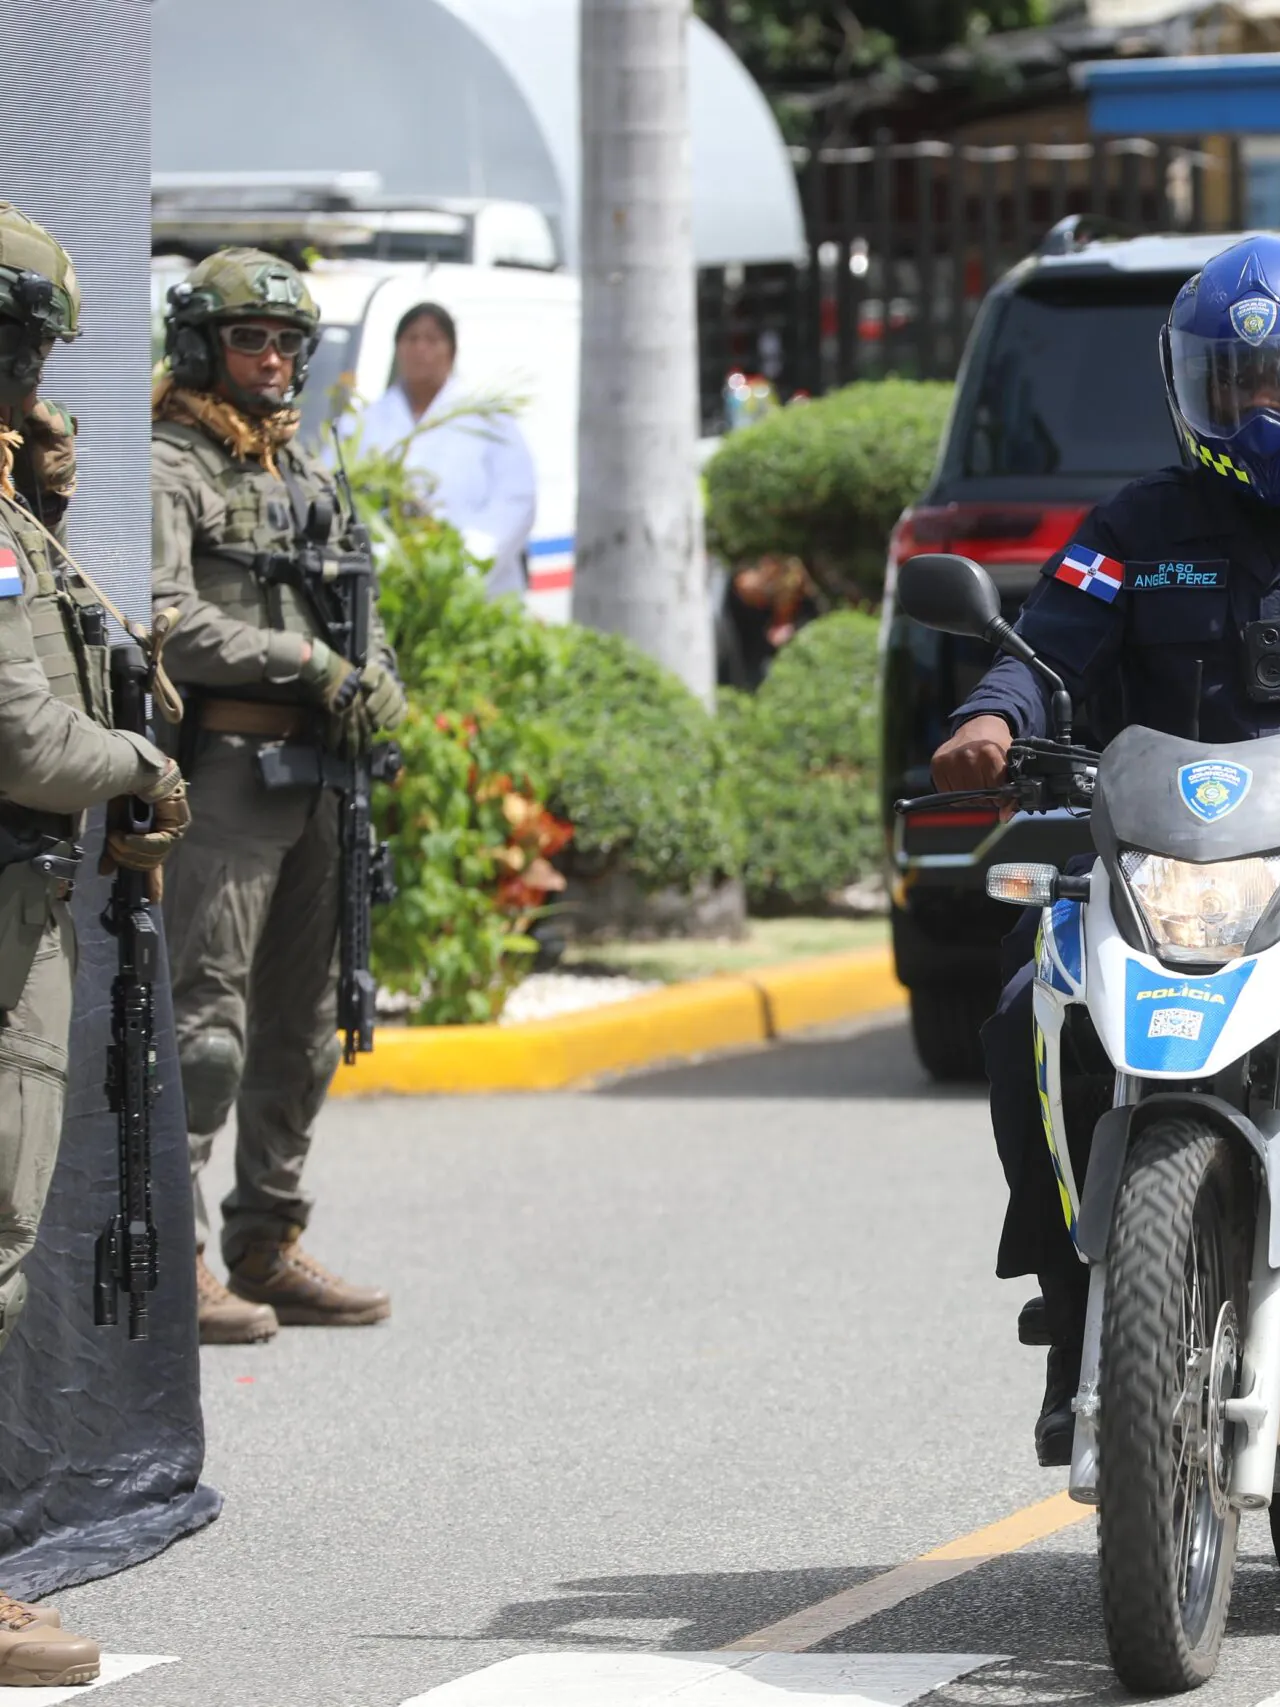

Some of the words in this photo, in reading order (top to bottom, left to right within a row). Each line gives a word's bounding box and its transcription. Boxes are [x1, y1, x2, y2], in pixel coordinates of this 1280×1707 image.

[1158, 563, 1194, 573] RASO
[1134, 573, 1171, 588] ANGEL
[1176, 572, 1218, 585] PEREZ
